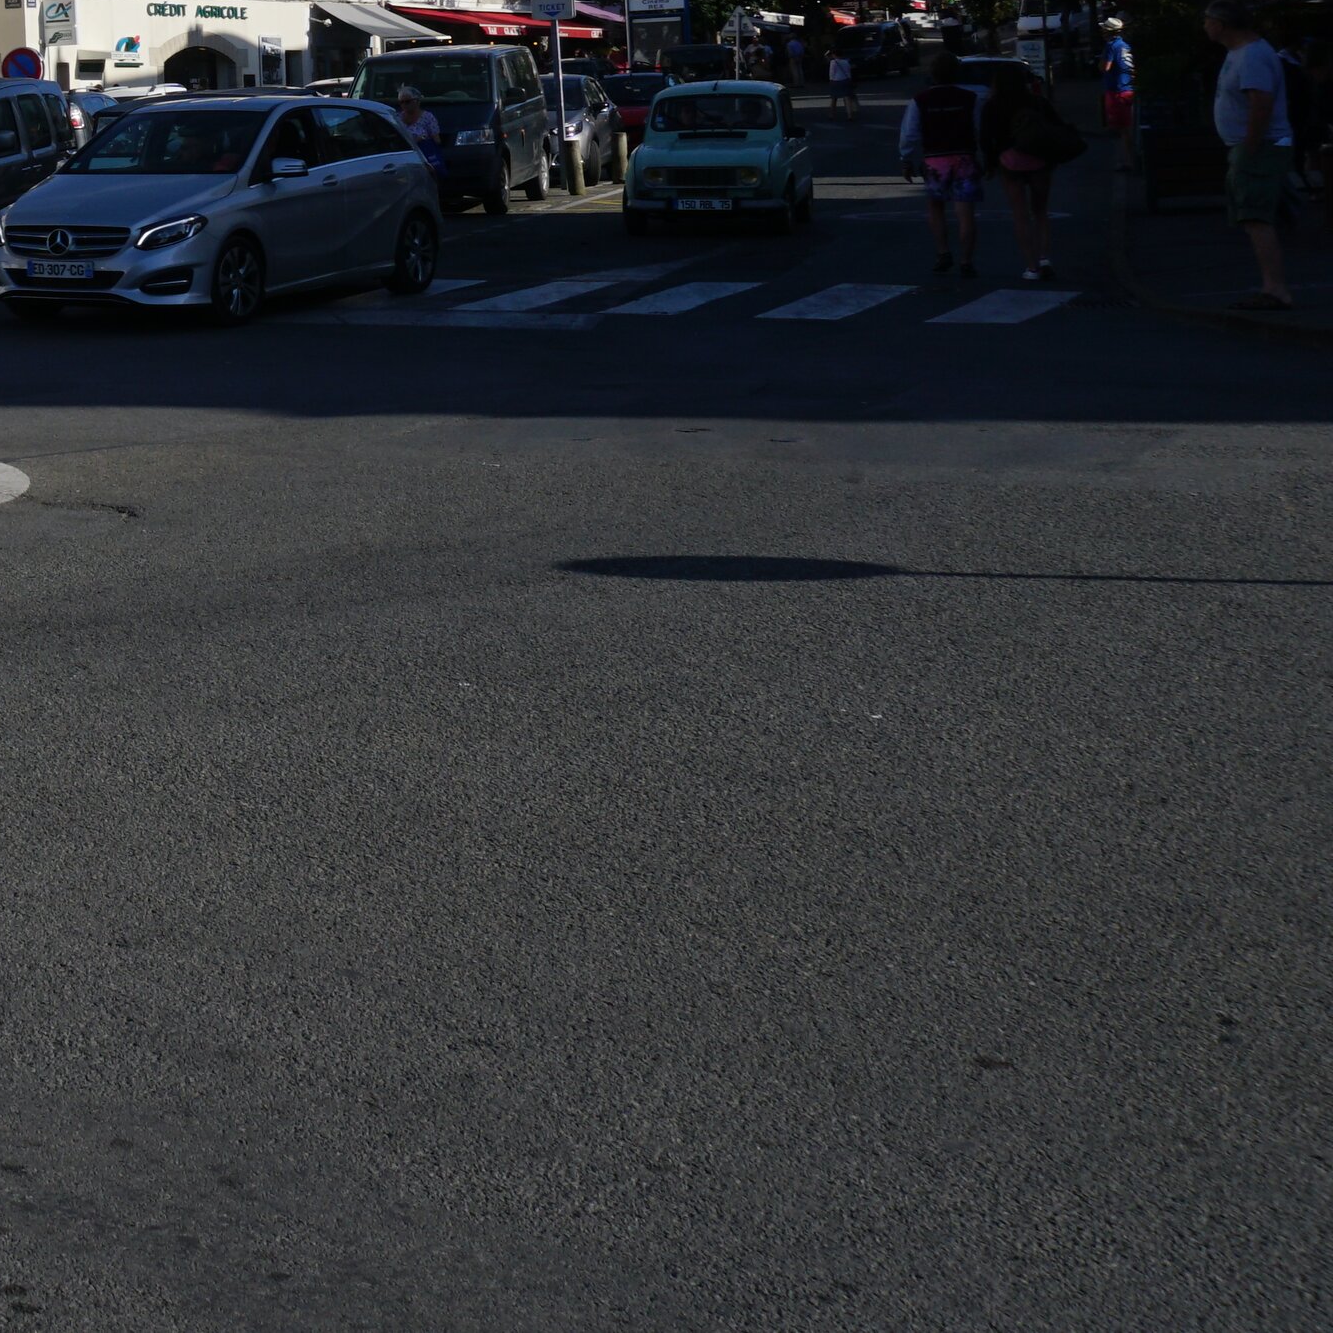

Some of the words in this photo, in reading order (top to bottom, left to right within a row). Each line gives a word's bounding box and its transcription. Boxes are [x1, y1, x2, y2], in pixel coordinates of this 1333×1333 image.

[147, 1, 187, 17] CRÉDIT
[195, 5, 248, 20] AGRICOLE
[539, 3, 565, 11] TICKET
